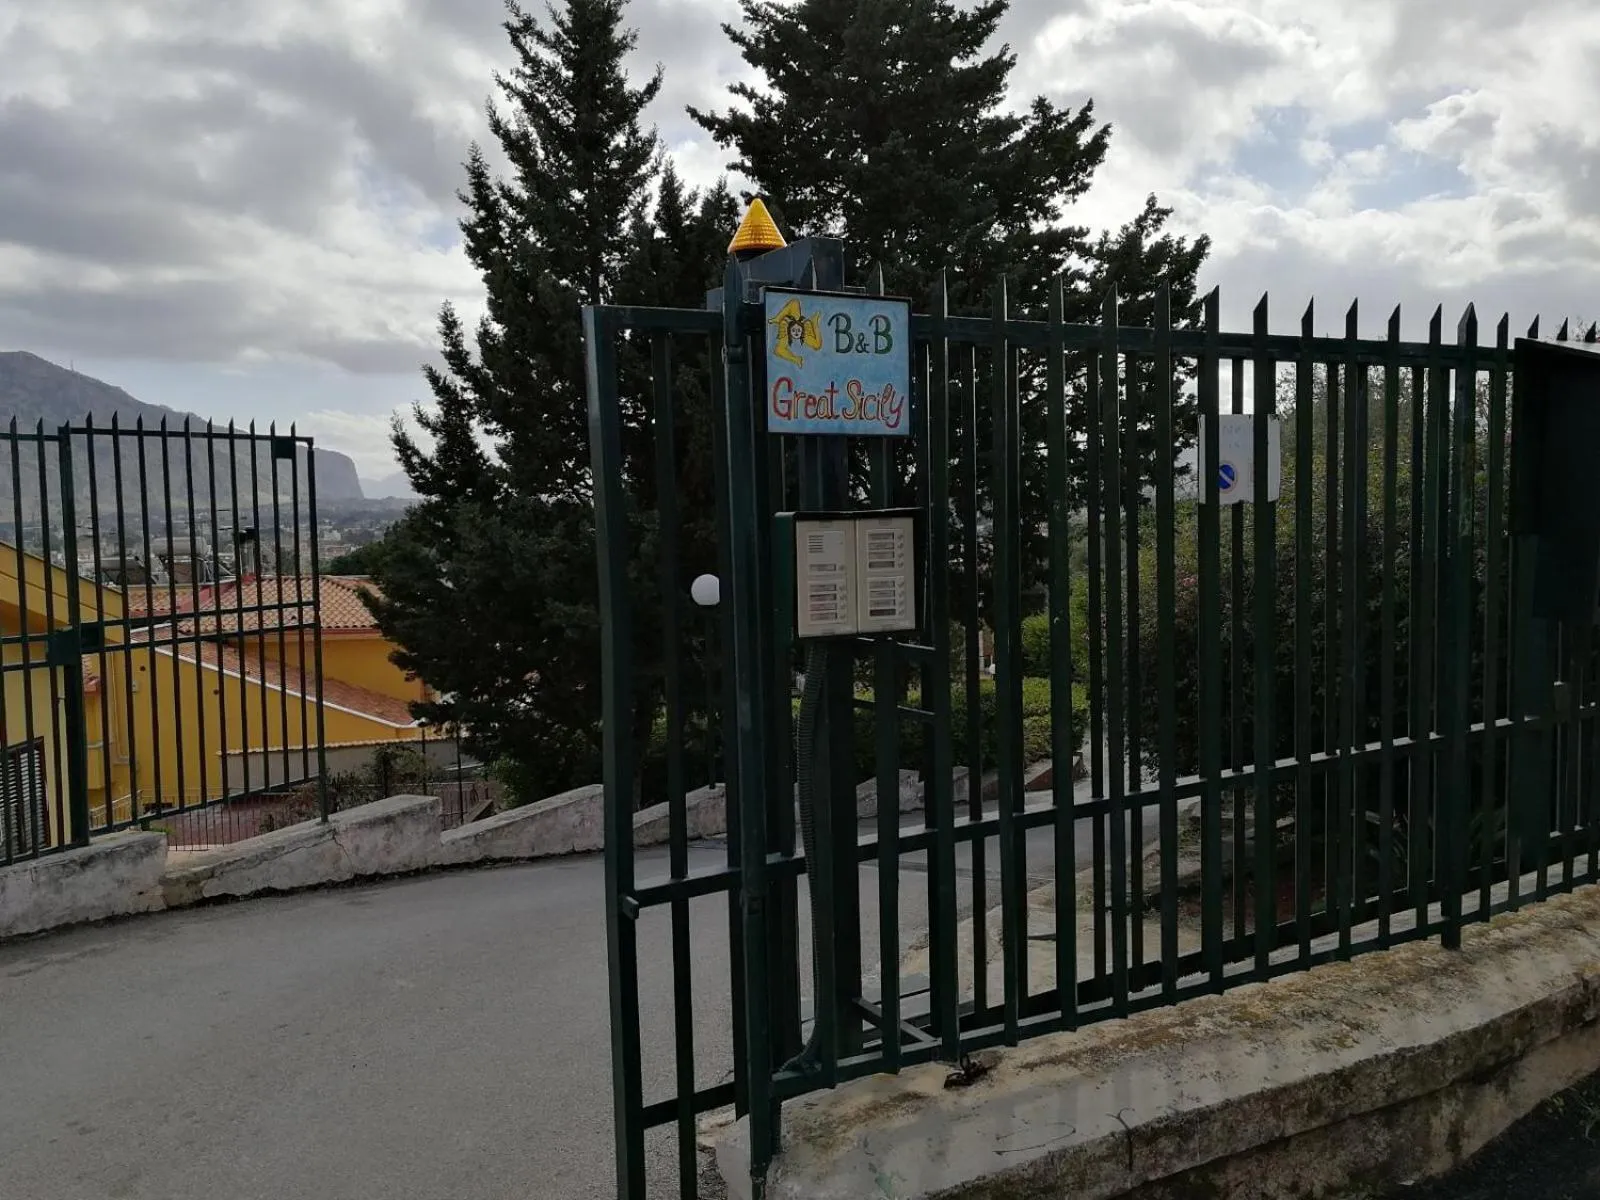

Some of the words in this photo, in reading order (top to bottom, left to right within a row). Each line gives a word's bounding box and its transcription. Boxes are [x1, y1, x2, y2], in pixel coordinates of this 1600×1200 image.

[827, 312, 894, 355] B&B
[773, 376, 840, 421] Great
[842, 379, 904, 429] Sicily
